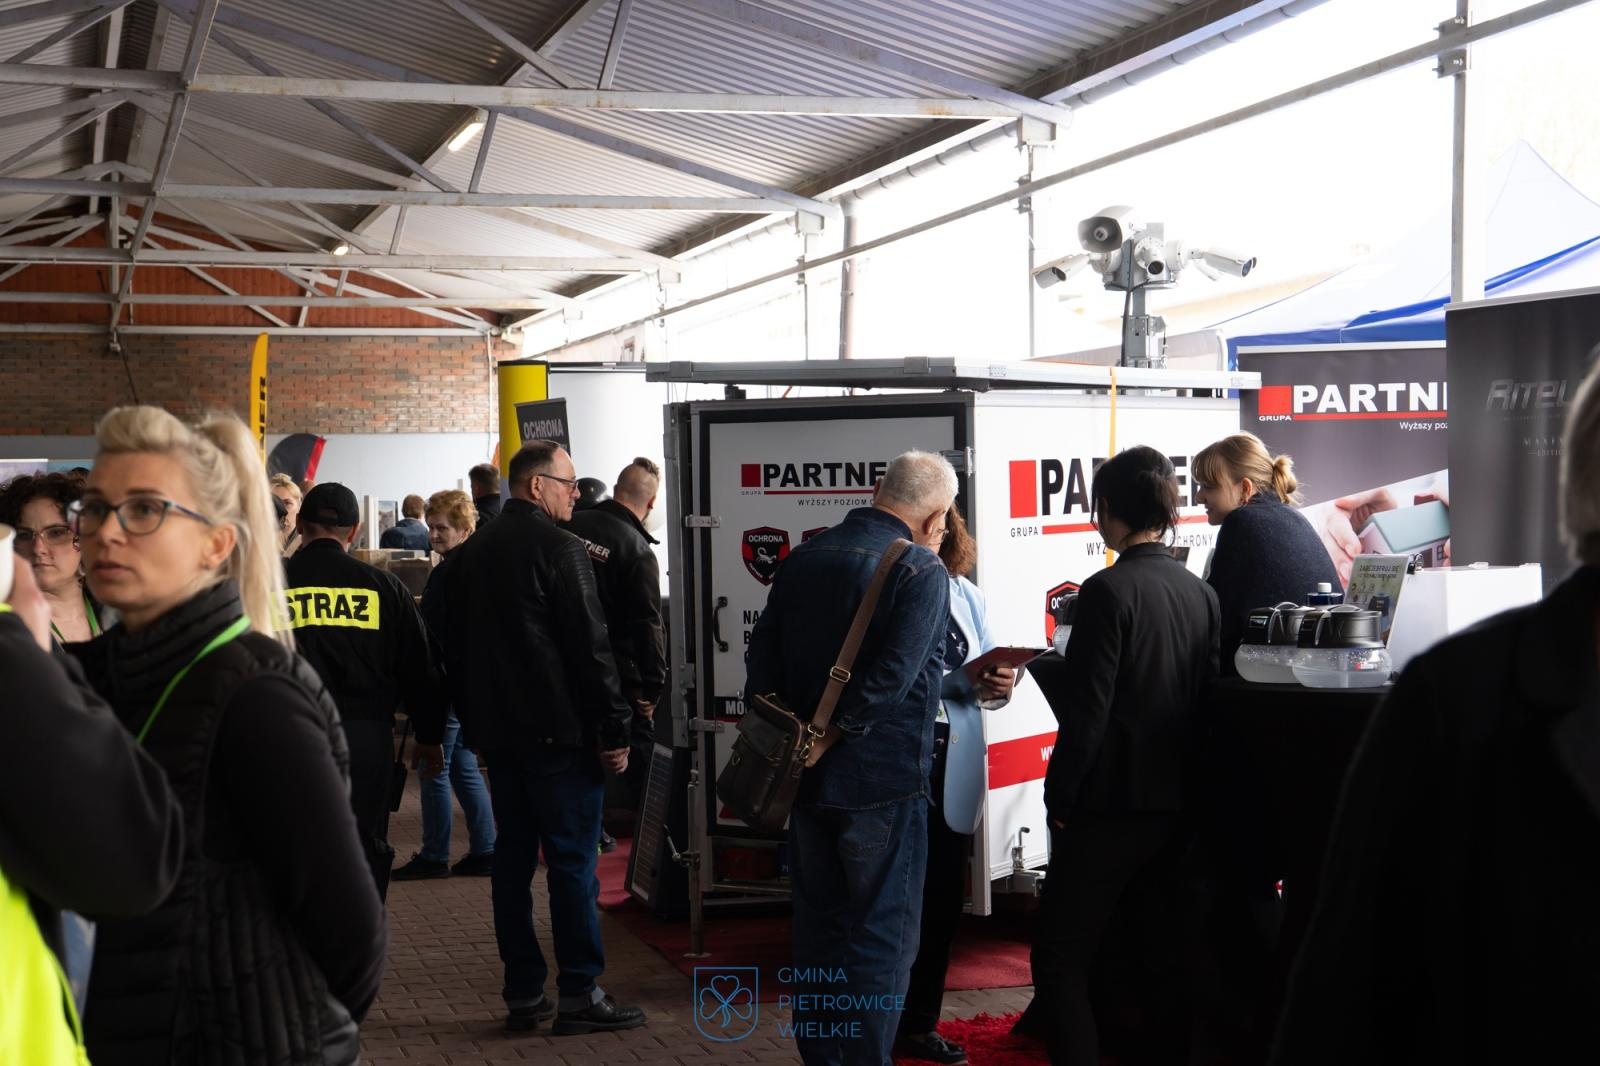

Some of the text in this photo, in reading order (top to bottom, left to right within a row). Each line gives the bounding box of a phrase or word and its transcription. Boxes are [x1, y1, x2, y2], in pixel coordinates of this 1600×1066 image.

[1293, 382, 1447, 414] PARTN
[523, 418, 564, 439] OCHRONA
[1400, 421, 1433, 432] Wyższy
[763, 461, 888, 488] PARTNE
[834, 498, 867, 506] POZIOM
[748, 534, 784, 543] OCHRONA
[1010, 526, 1039, 538] GRUPA
[1176, 533, 1213, 547] CHRONY
[584, 539, 611, 558] TNER
